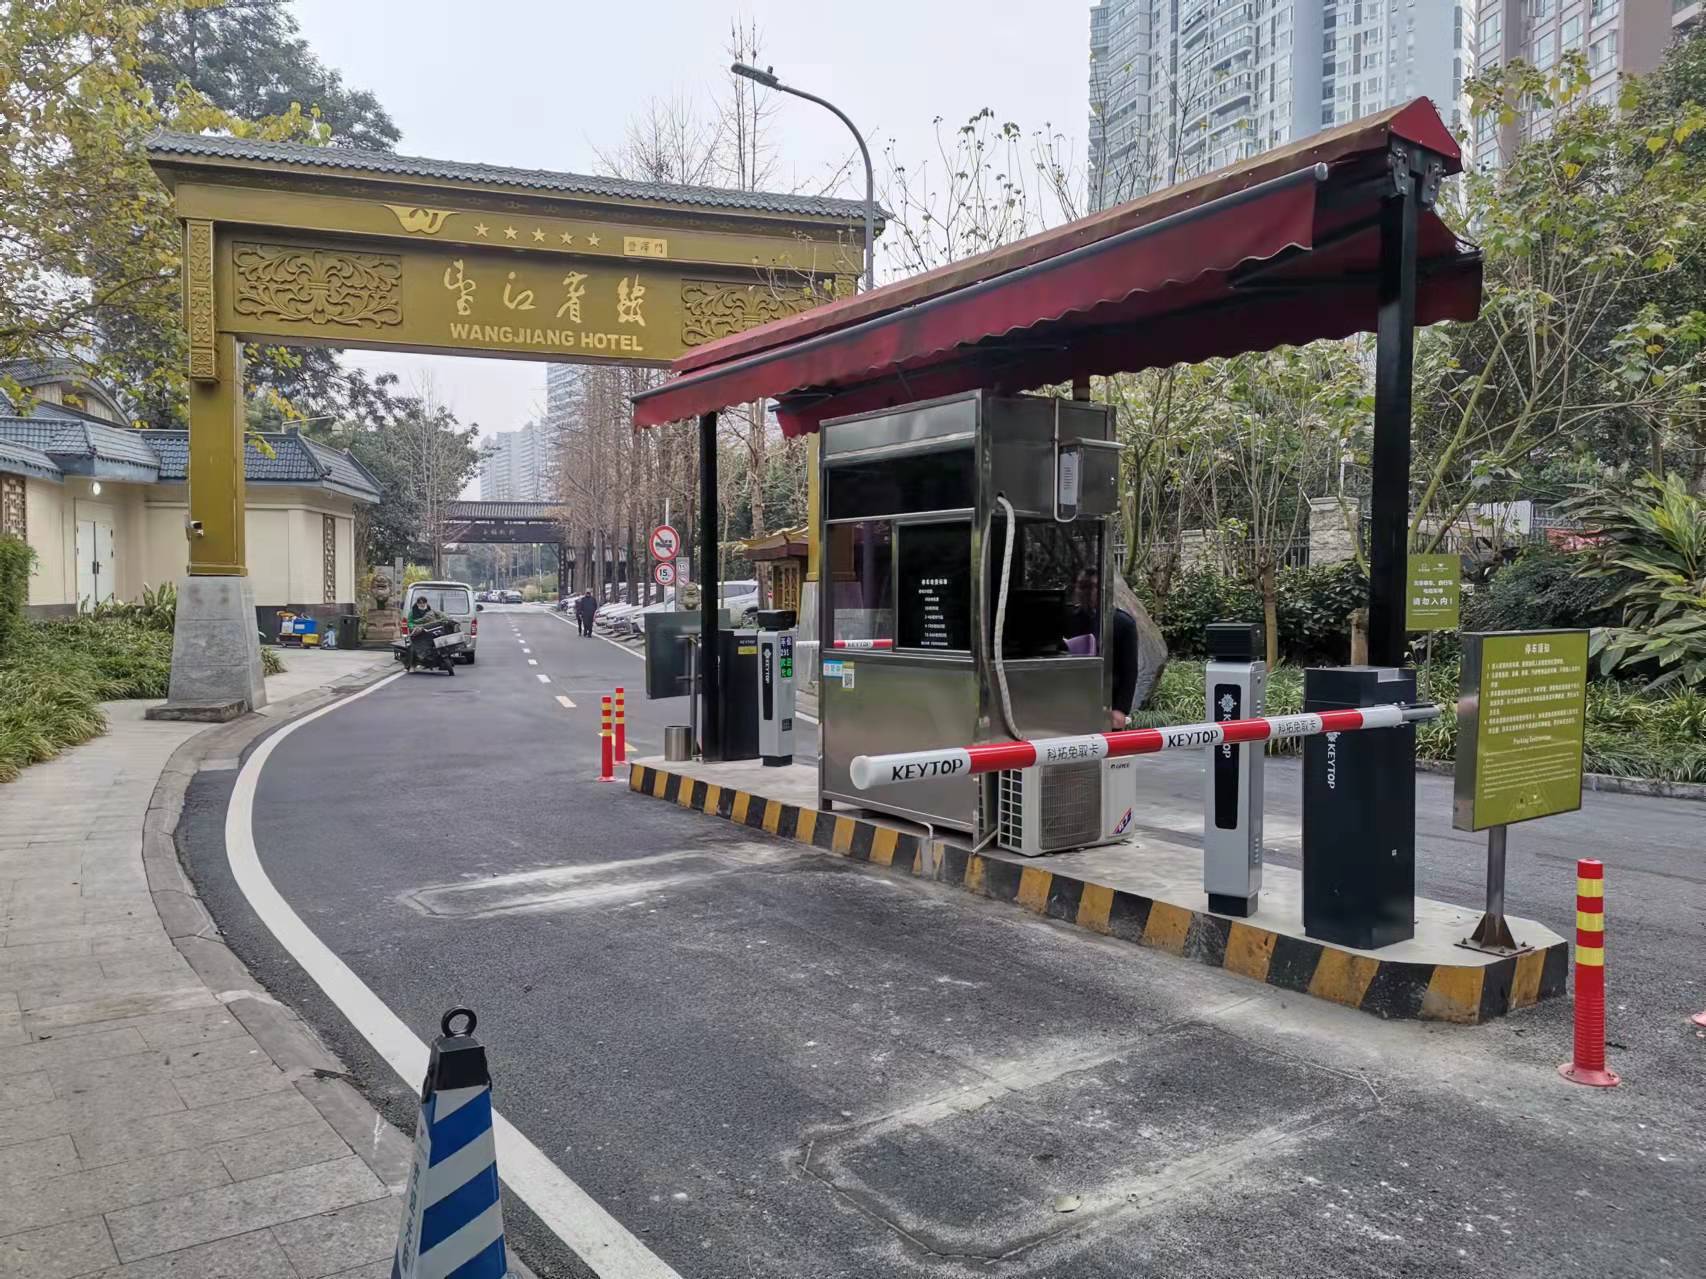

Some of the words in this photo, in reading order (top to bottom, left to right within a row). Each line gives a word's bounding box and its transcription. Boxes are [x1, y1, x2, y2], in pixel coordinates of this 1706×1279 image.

[450, 323, 575, 346] WANGJIANG
[581, 332, 644, 351] HOTEL
[1167, 729, 1219, 748] KEYTOP
[1222, 713, 1232, 759] KOP
[1046, 743, 1100, 762] 科拓免取卡
[891, 758, 964, 782] KEYTOP
[1327, 743, 1336, 790] KEYTOP
